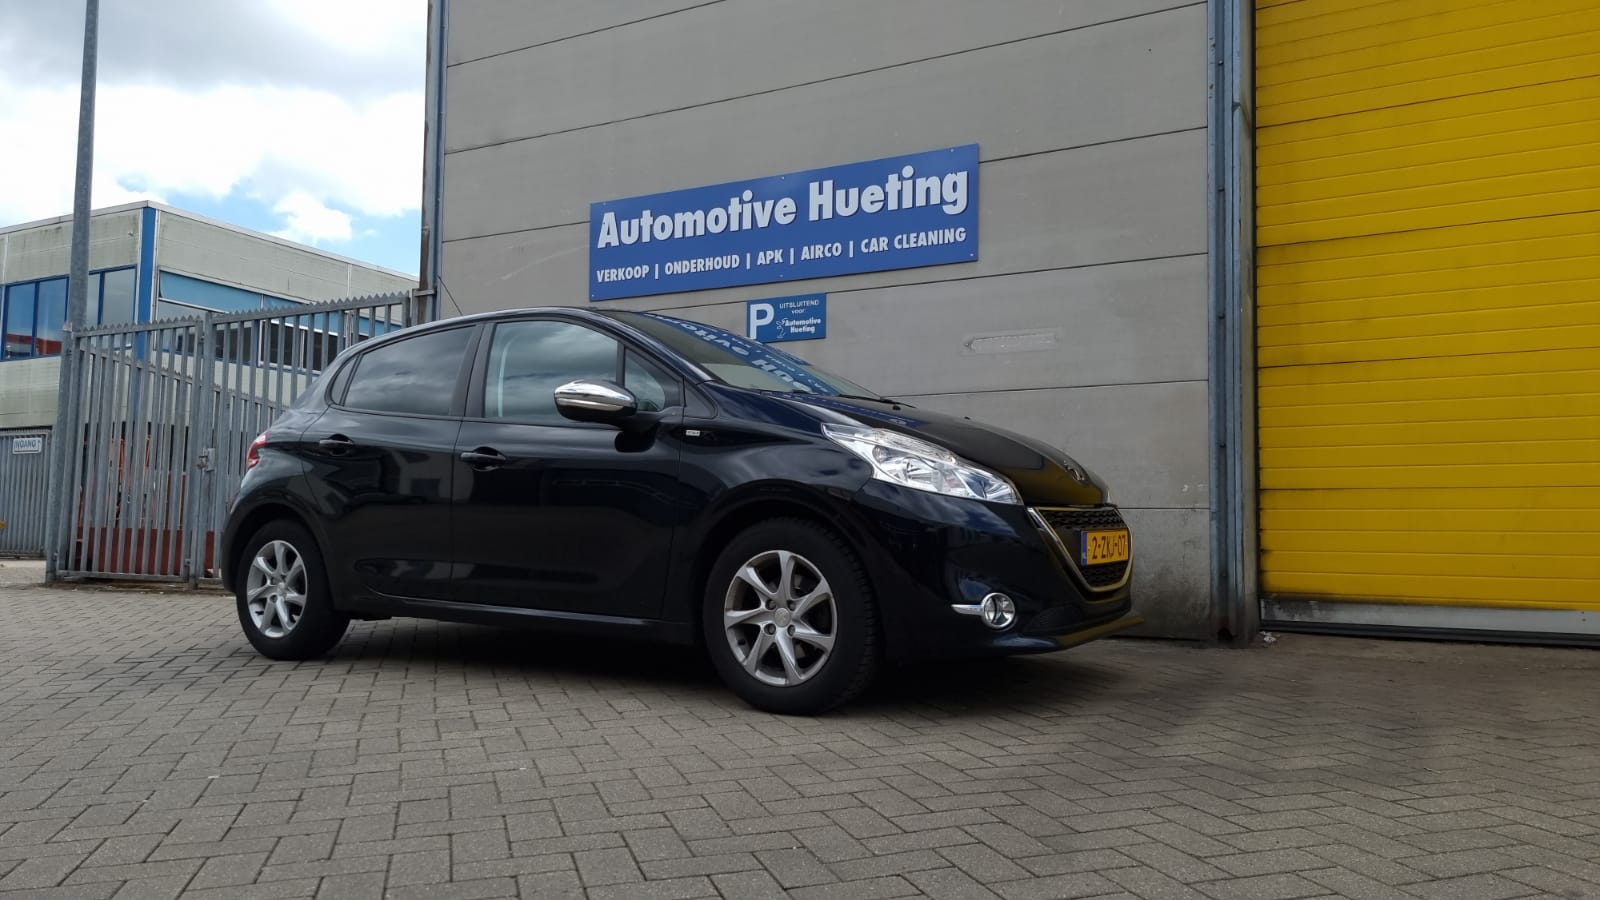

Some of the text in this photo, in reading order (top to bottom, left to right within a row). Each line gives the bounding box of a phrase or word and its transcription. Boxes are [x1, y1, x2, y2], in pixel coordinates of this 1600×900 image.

[597, 165, 968, 249] Automotive Hueting
[596, 227, 967, 283] VERKOOP ONDERHOUD APK AIRCO CAR CLEANING
[779, 299, 820, 310] UITSLUITEND
[749, 303, 775, 340] P
[784, 316, 822, 327] Automotive
[790, 325, 816, 334] Hueting
[1091, 534, 1126, 560] 2-ZKJ-07
